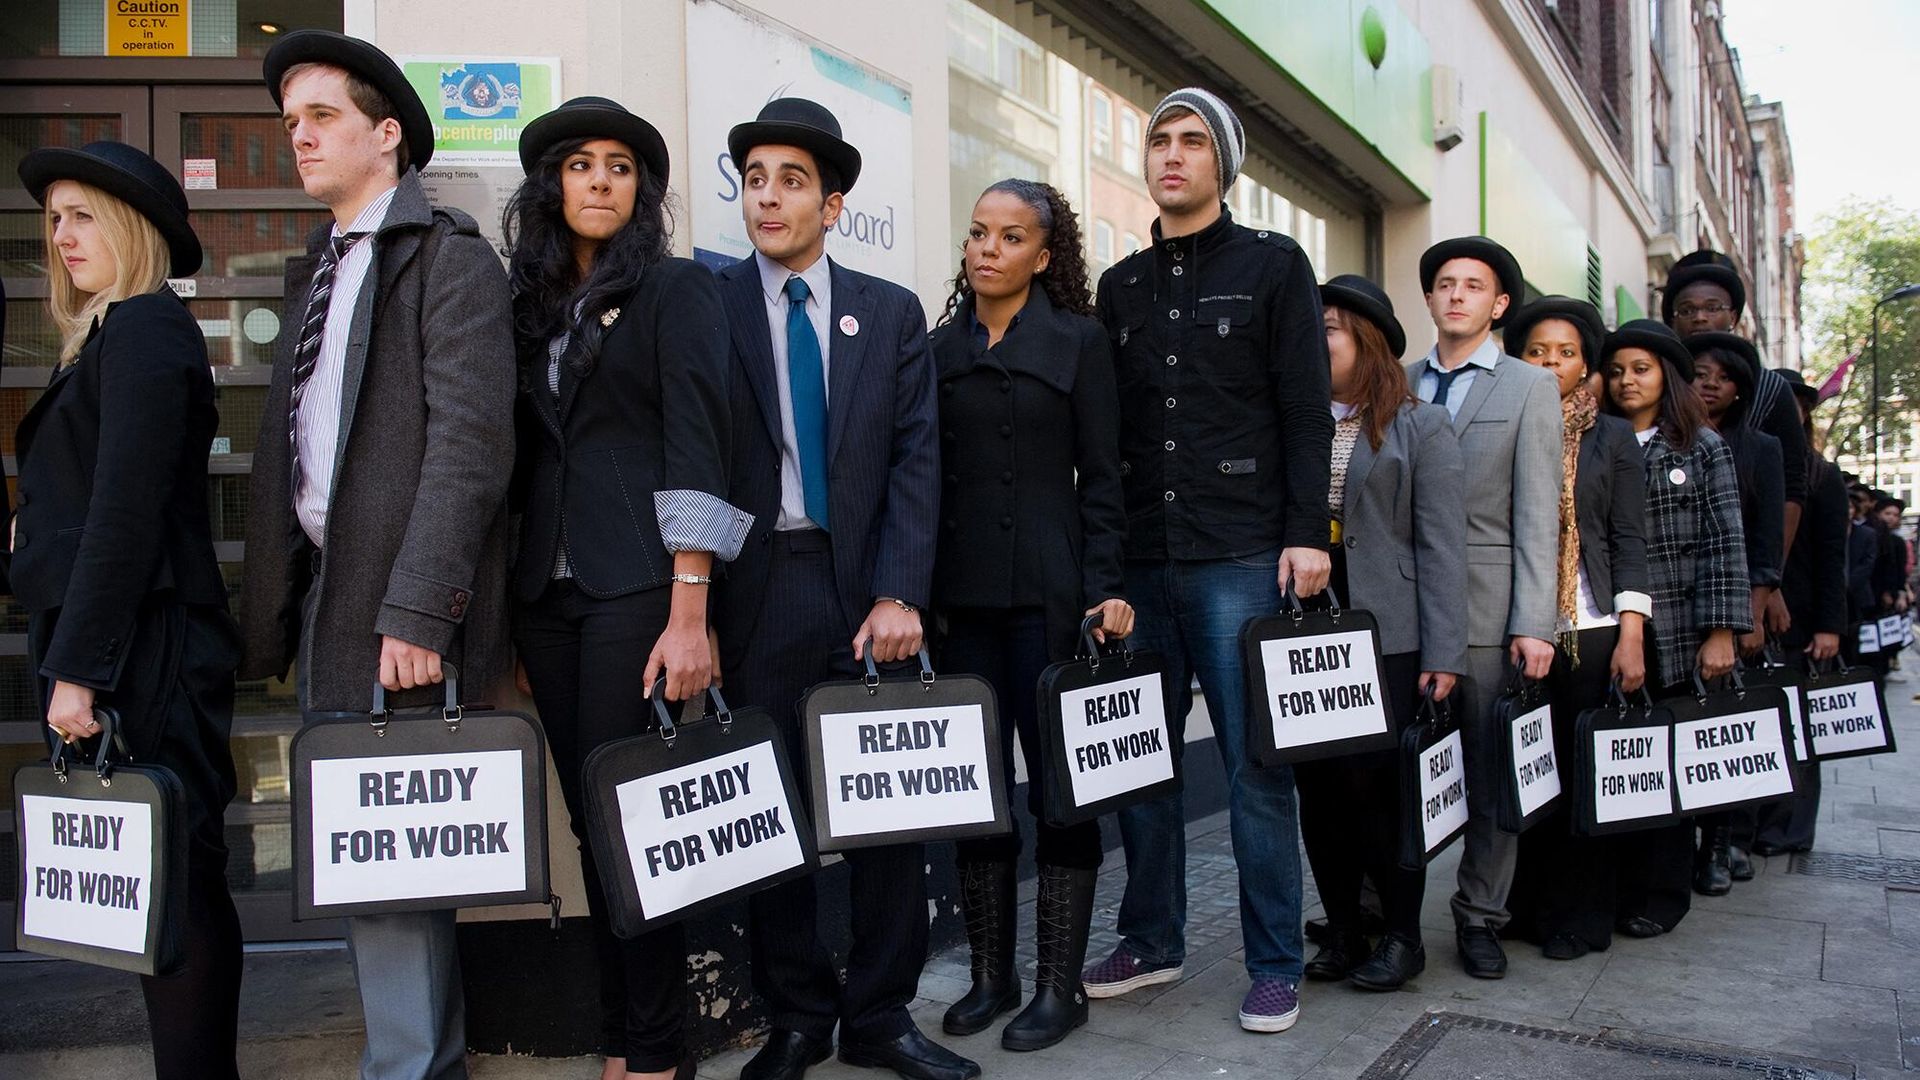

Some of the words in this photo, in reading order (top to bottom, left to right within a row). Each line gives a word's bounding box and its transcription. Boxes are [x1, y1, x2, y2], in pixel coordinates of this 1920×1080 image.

[117, 0, 179, 13] Caution
[122, 41, 175, 50] operation
[143, 30, 153, 38] in
[417, 169, 453, 180] Opening
[455, 169, 478, 179] times
[171, 282, 187, 292] PULL
[1288, 644, 1351, 675] READY
[1085, 688, 1140, 726] READY
[1278, 691, 1316, 718] FOR
[1318, 683, 1374, 711] WORK
[1808, 691, 1857, 713] READY
[859, 719, 949, 754] READY
[1521, 718, 1542, 748] READY
[1695, 721, 1755, 750] READY
[1831, 716, 1876, 734] WORK
[1076, 742, 1112, 772] FOR
[1112, 728, 1162, 762] WORK
[1429, 745, 1453, 782] READY
[1612, 737, 1653, 760] READY
[840, 772, 892, 802] FOR
[898, 765, 979, 796] WORK
[1520, 763, 1534, 788] FOR
[1533, 752, 1554, 778] WORK
[1602, 776, 1625, 796] FOR
[1628, 771, 1664, 793] WORK
[1685, 762, 1721, 784] FOR
[1723, 752, 1779, 777] WORK
[360, 768, 478, 806] READY
[659, 762, 751, 819] READY
[1426, 794, 1441, 822] FOR
[1442, 778, 1464, 810] WORK
[52, 812, 123, 850] READY
[332, 830, 396, 864] FOR
[406, 822, 509, 858] WORK
[645, 835, 706, 878] FOR
[708, 806, 786, 856] WORK
[36, 867, 72, 901] FOR
[78, 872, 140, 910] WORK
